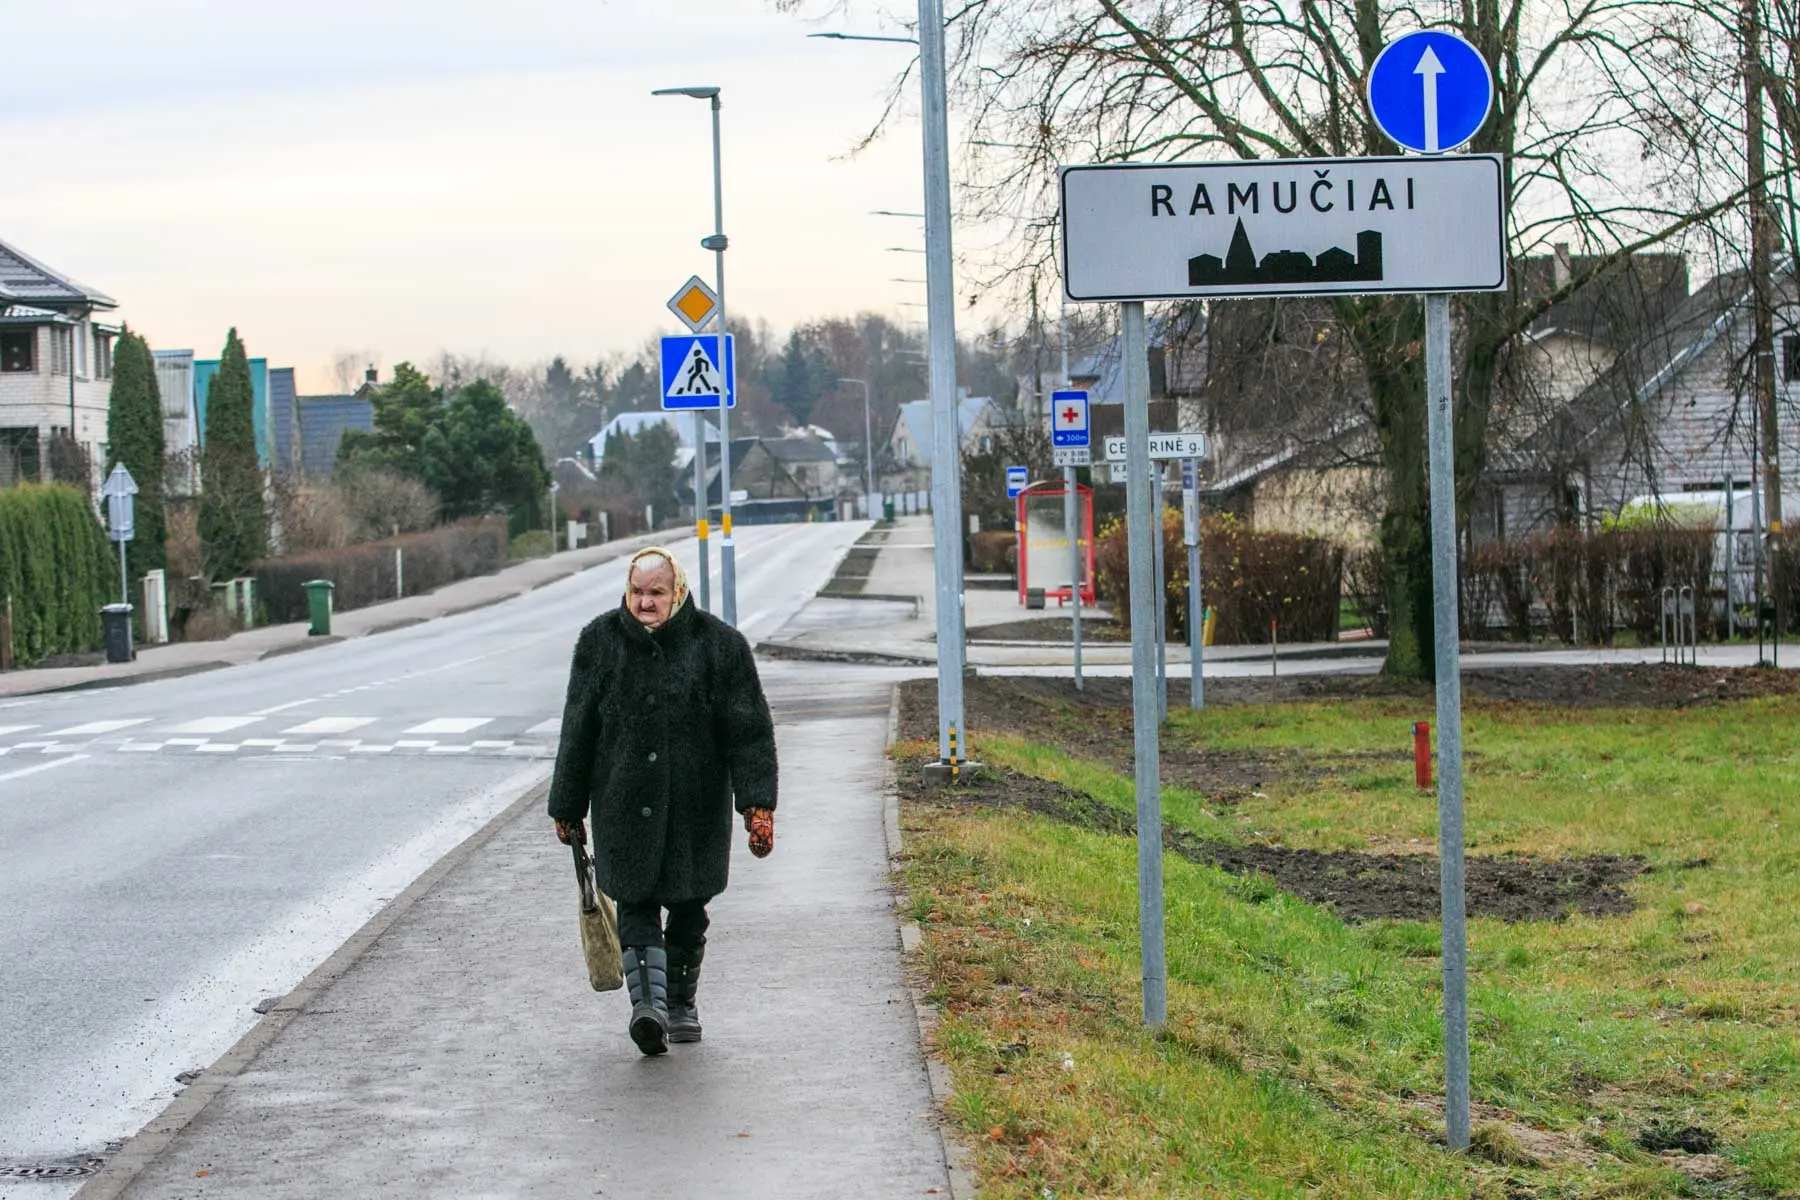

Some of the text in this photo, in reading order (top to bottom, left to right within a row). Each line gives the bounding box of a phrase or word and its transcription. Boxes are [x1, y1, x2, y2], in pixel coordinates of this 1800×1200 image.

[1151, 169, 1415, 217] RAMUČIAI
[1109, 437, 1201, 454] CERINĖ g.
